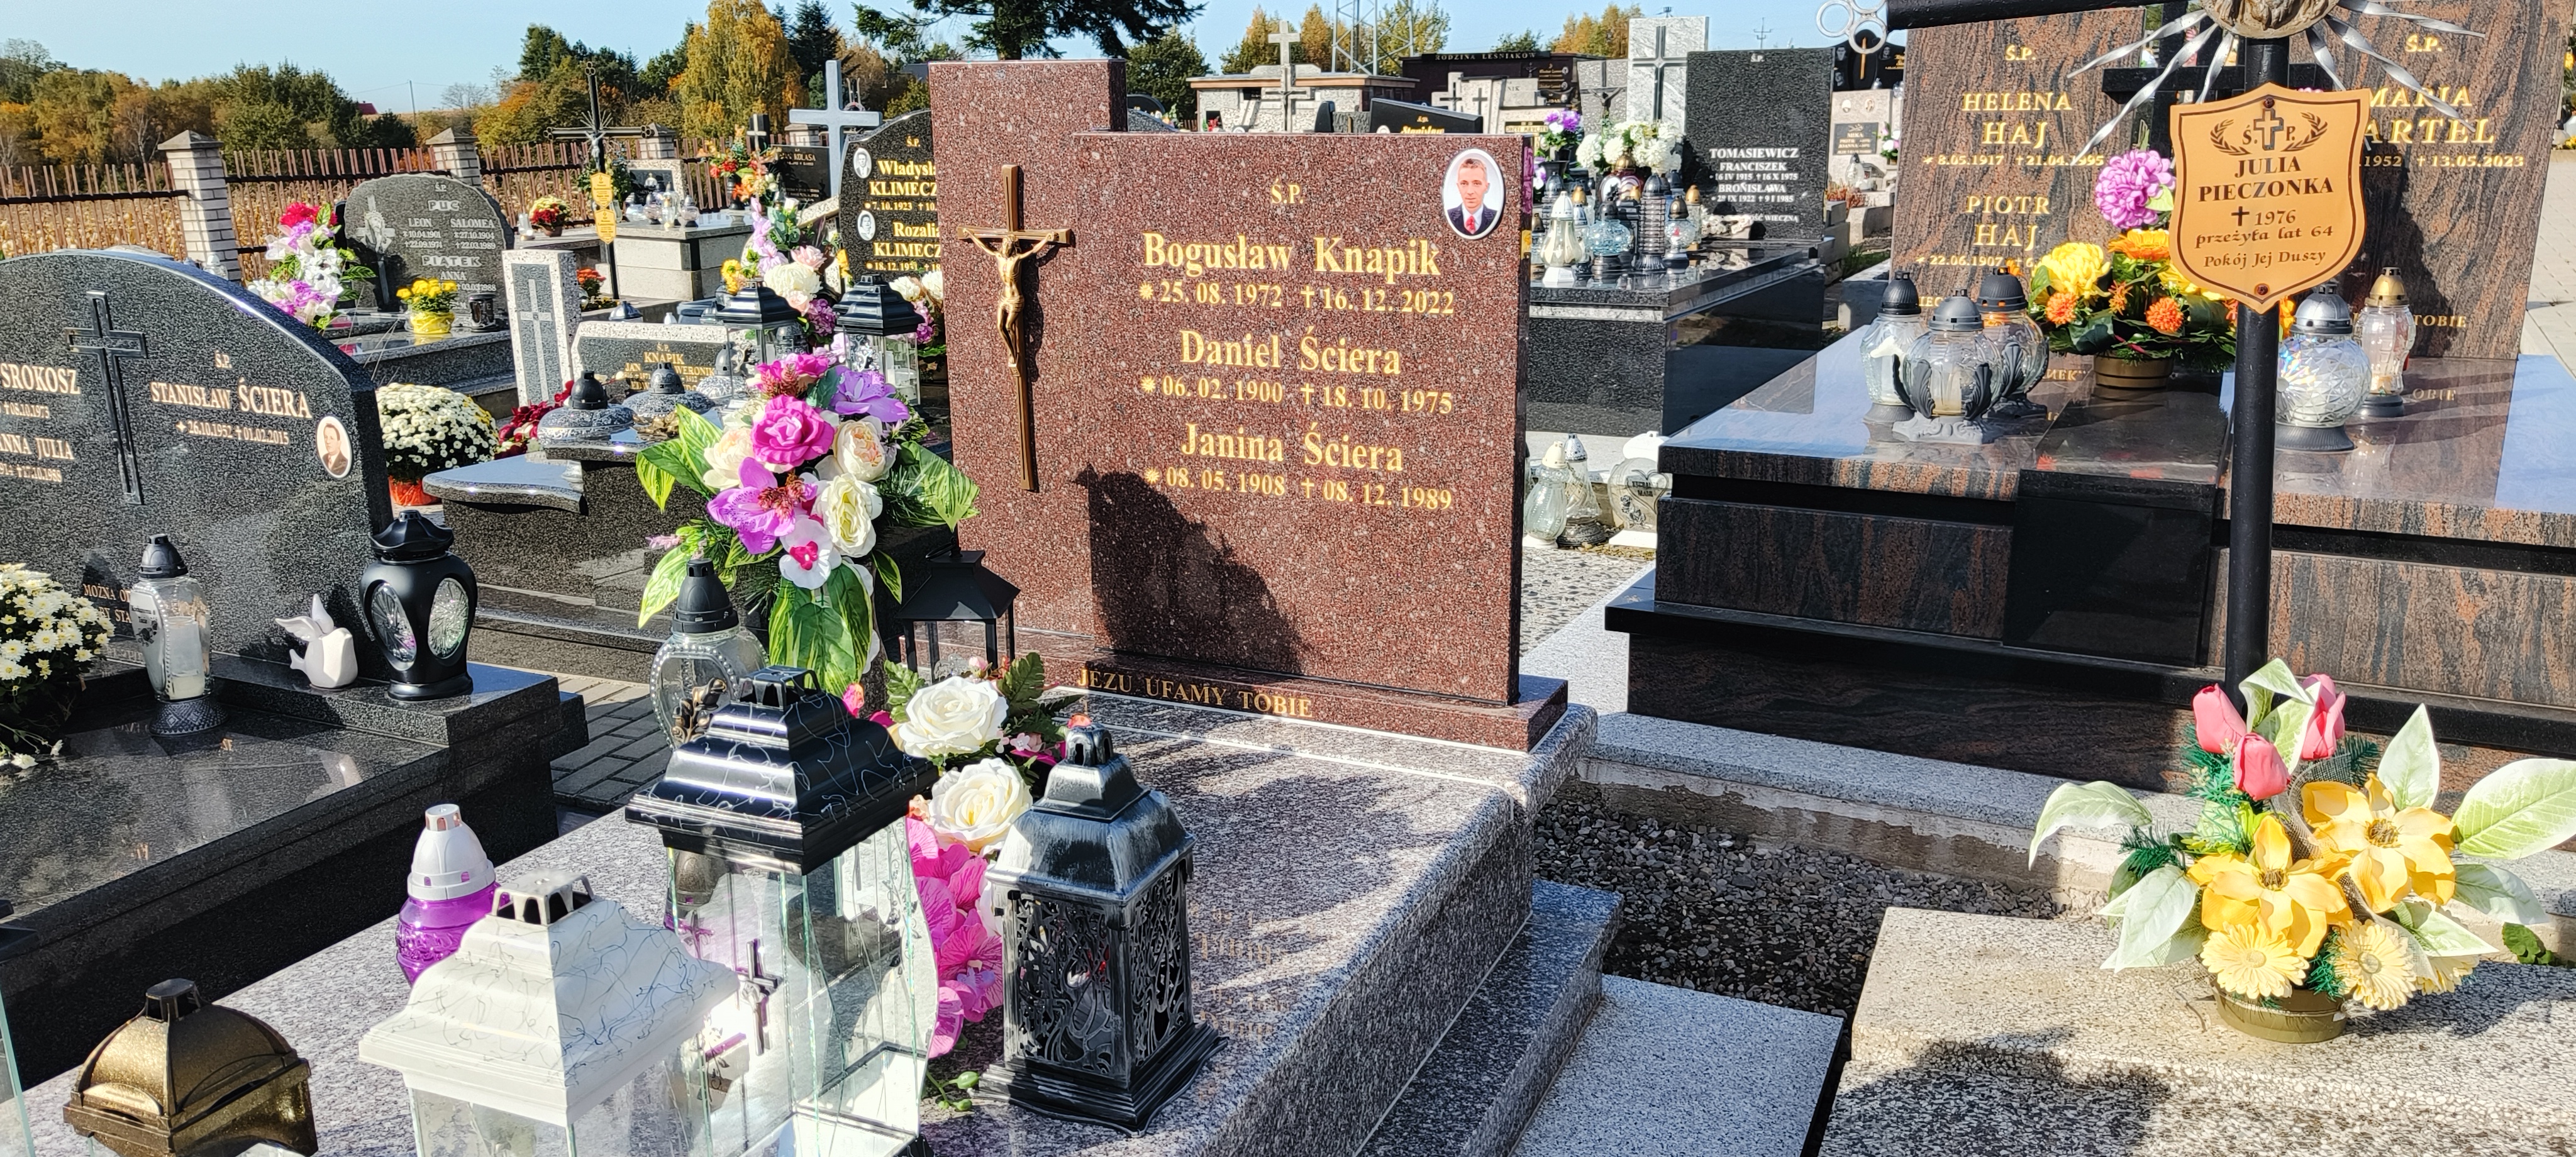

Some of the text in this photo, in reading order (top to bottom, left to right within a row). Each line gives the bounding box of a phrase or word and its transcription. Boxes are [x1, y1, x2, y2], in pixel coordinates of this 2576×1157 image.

[1962, 91, 2072, 111] HELENA
[1982, 121, 2048, 149] HAJ
[2365, 119, 2494, 144] ARTEL
[1709, 148, 1799, 158] TOMASIEWICZ
[1938, 155, 2004, 165] 8.05.1917
[2432, 155, 2524, 167] 13.05.2023
[1719, 162, 1787, 171] FRANCISZEK
[2235, 156, 2301, 178] JULIA
[869, 181, 937, 196] KLIMECZ
[1271, 179, 1304, 205] Ś.P.
[2198, 177, 2333, 202] PIECZONKA
[428, 200, 460, 211] PUC
[1965, 196, 2050, 214] PIOTR
[409, 218, 495, 228] LEON SALOMEA
[2255, 209, 2296, 226] 1976
[1973, 224, 2038, 251] HAJ
[2194, 225, 2333, 249] przeżyła lat 64
[874, 242, 941, 258] KLIMECZ
[1142, 231, 1441, 285] Bogusław Knapik
[1929, 255, 2003, 266] 22.06.1907
[2203, 251, 2326, 270] Pokój Jej Duszy
[440, 271, 467, 280] ANNA
[1234, 284, 1282, 307] 1972
[1401, 291, 1454, 314] 2022
[215, 350, 232, 368] Ś.P.
[644, 352, 685, 365] KNAPIK
[1179, 325, 1401, 375] Daniel Ściera
[0, 363, 80, 394] SROKOSZ
[625, 363, 715, 375] JAN WERONIK
[150, 377, 313, 418] STANISŁAW ŚCIERA
[1235, 379, 1283, 403] 1900
[1401, 390, 1453, 414] 1975
[35, 436, 74, 461] JULIA
[1180, 422, 1403, 472] Janina Ściera
[1238, 472, 1285, 497] 1908
[1401, 485, 1452, 510] 1989
[82, 583, 116, 601] MOŻNA
[114, 609, 131, 623] STA
[1078, 667, 1314, 717] JEZU UFAMY TOBIE
